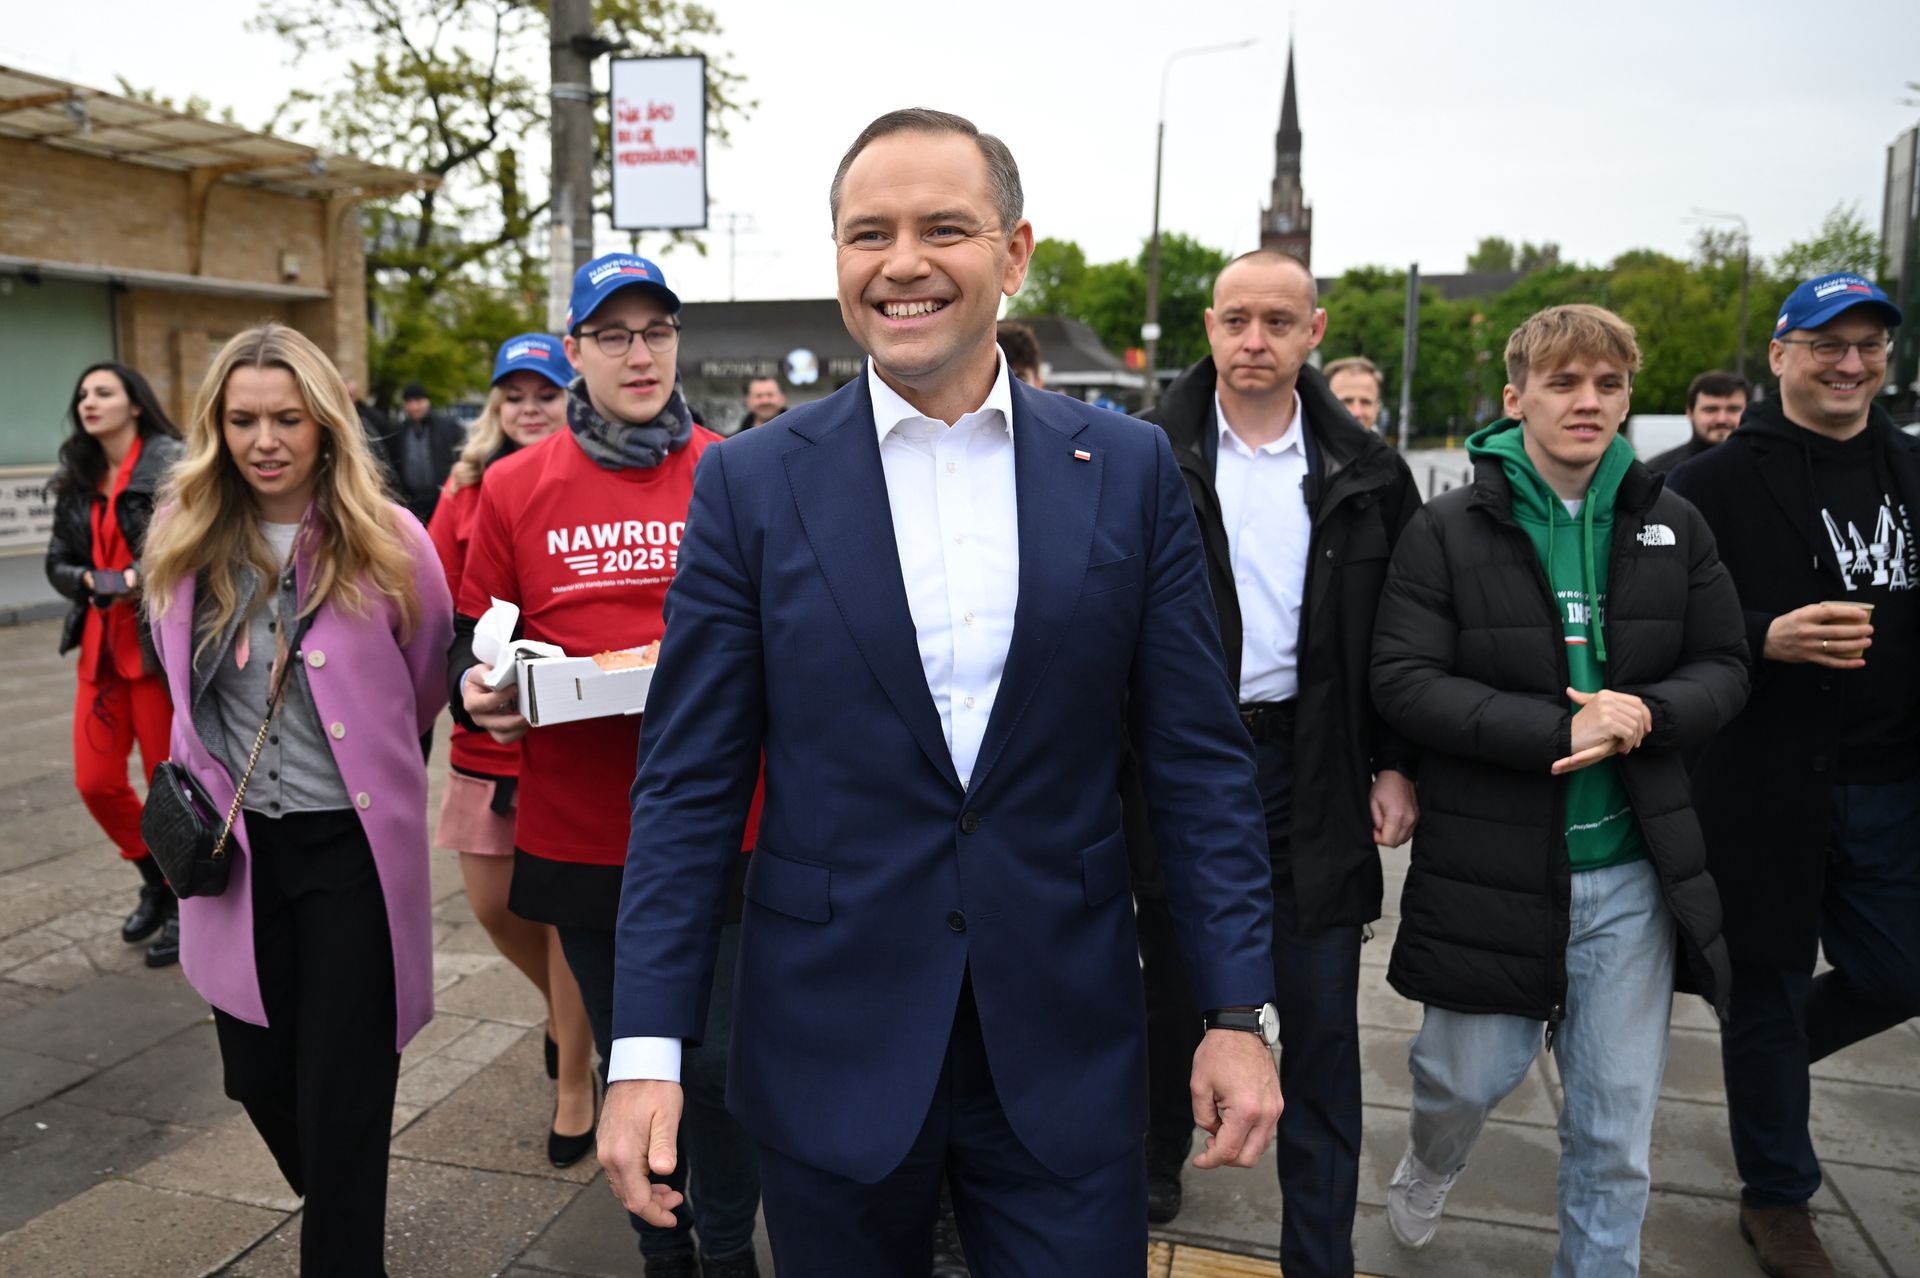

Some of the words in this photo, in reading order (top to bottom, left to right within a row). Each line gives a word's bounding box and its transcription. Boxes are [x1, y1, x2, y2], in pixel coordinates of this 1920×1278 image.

[588, 259, 645, 278] NAWROCKI
[547, 520, 685, 555] NAWROC
[602, 547, 665, 573] 2025
